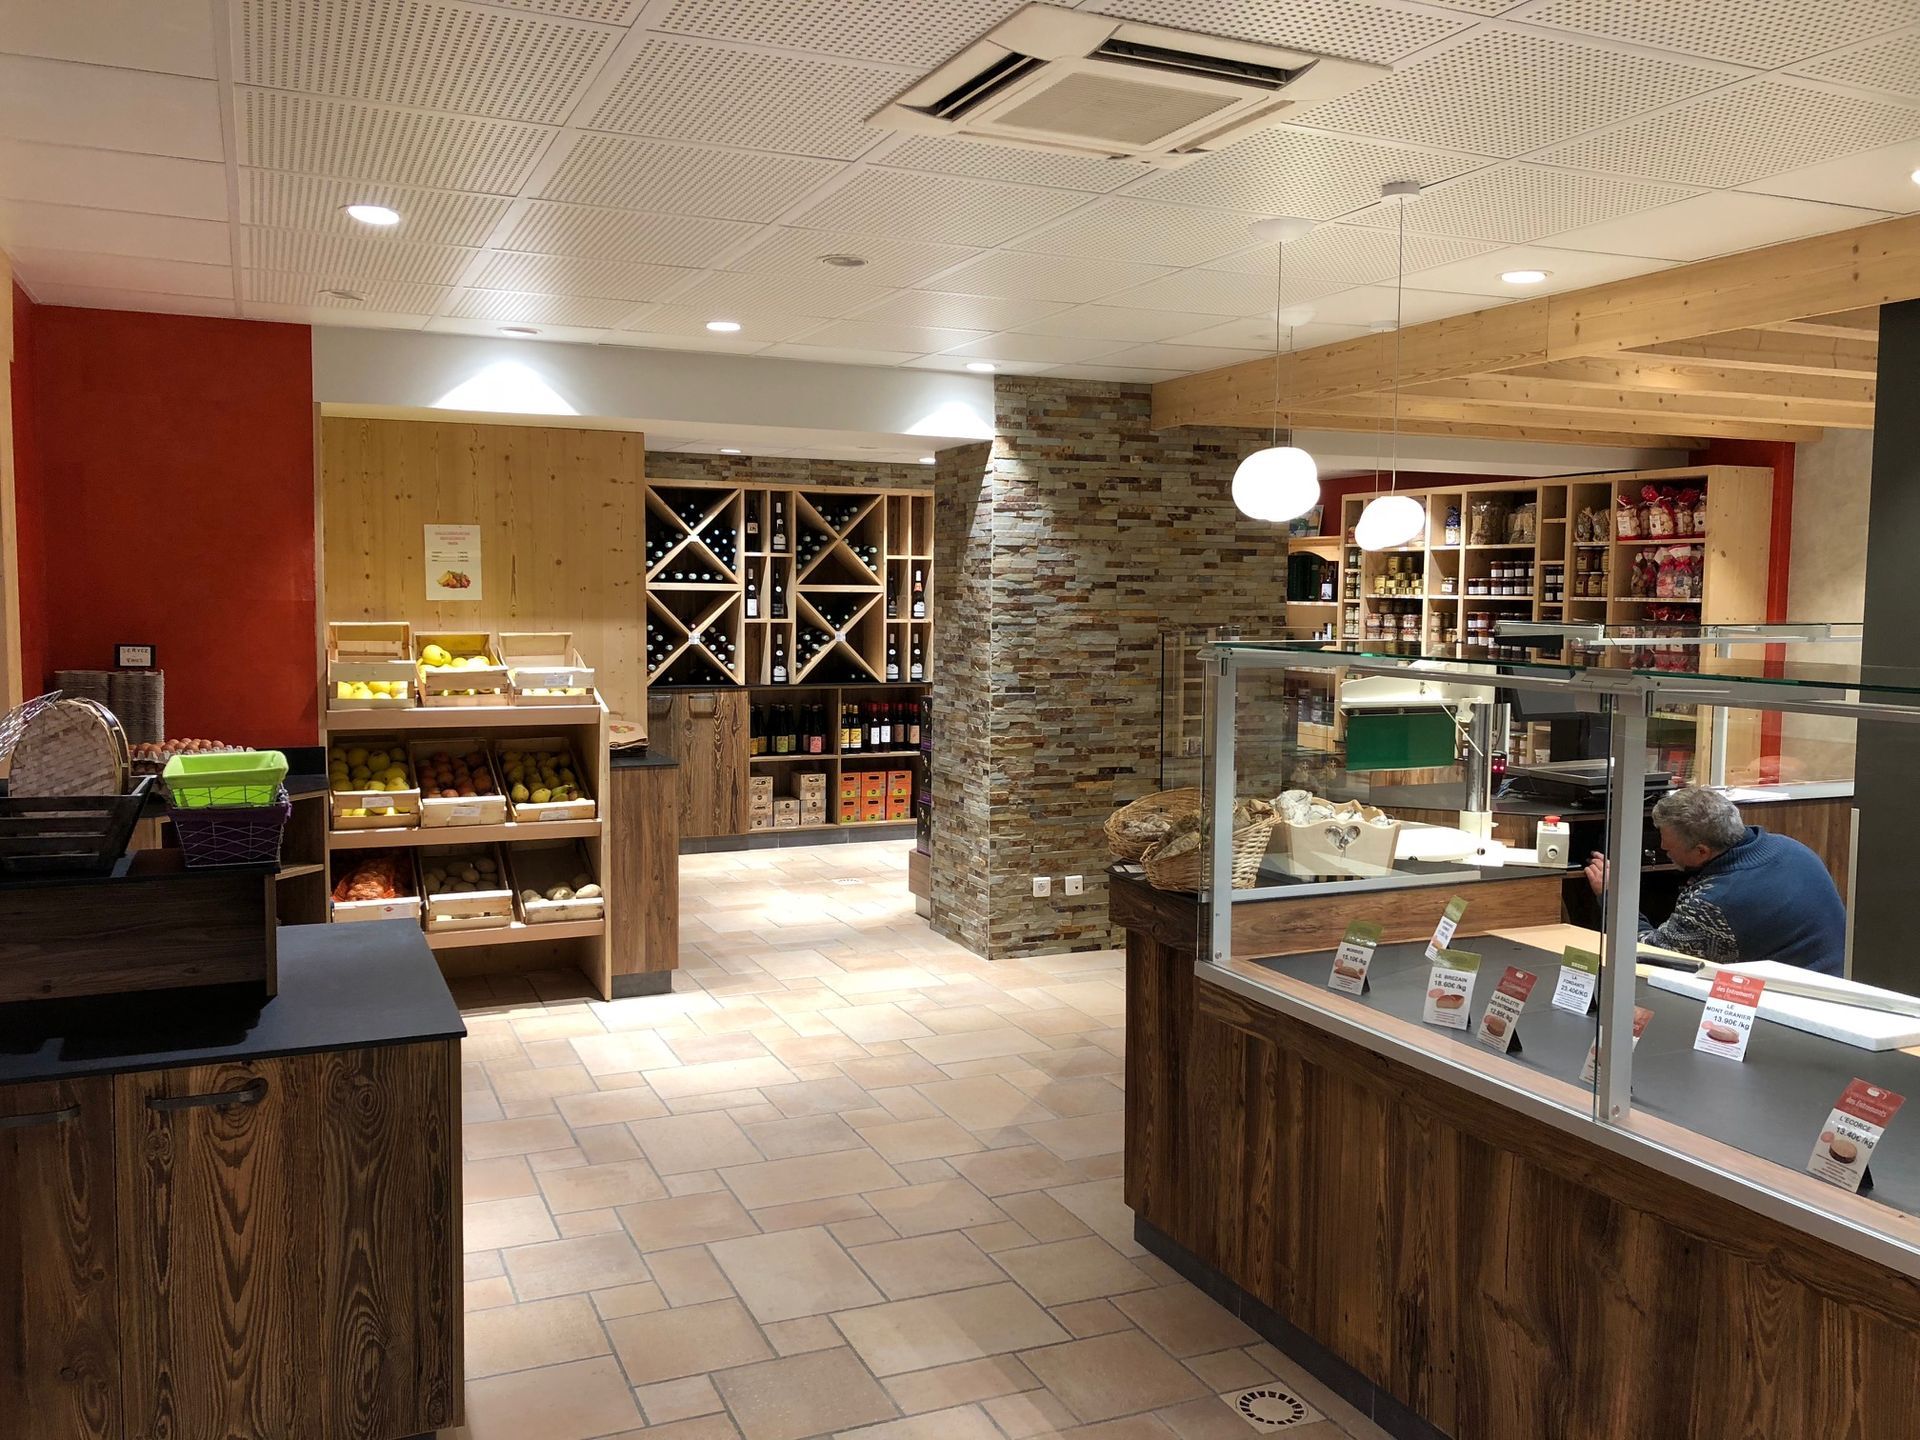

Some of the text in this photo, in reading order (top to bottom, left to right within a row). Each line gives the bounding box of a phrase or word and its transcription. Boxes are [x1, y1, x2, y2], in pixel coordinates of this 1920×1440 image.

[1706, 1005, 1752, 1021] MONT GRANIER
[1714, 1015, 1750, 1031] 13.90€ /kg
[1839, 1115, 1873, 1132] L'ECORCE
[1836, 1126, 1875, 1149] 13.40€ /kg
